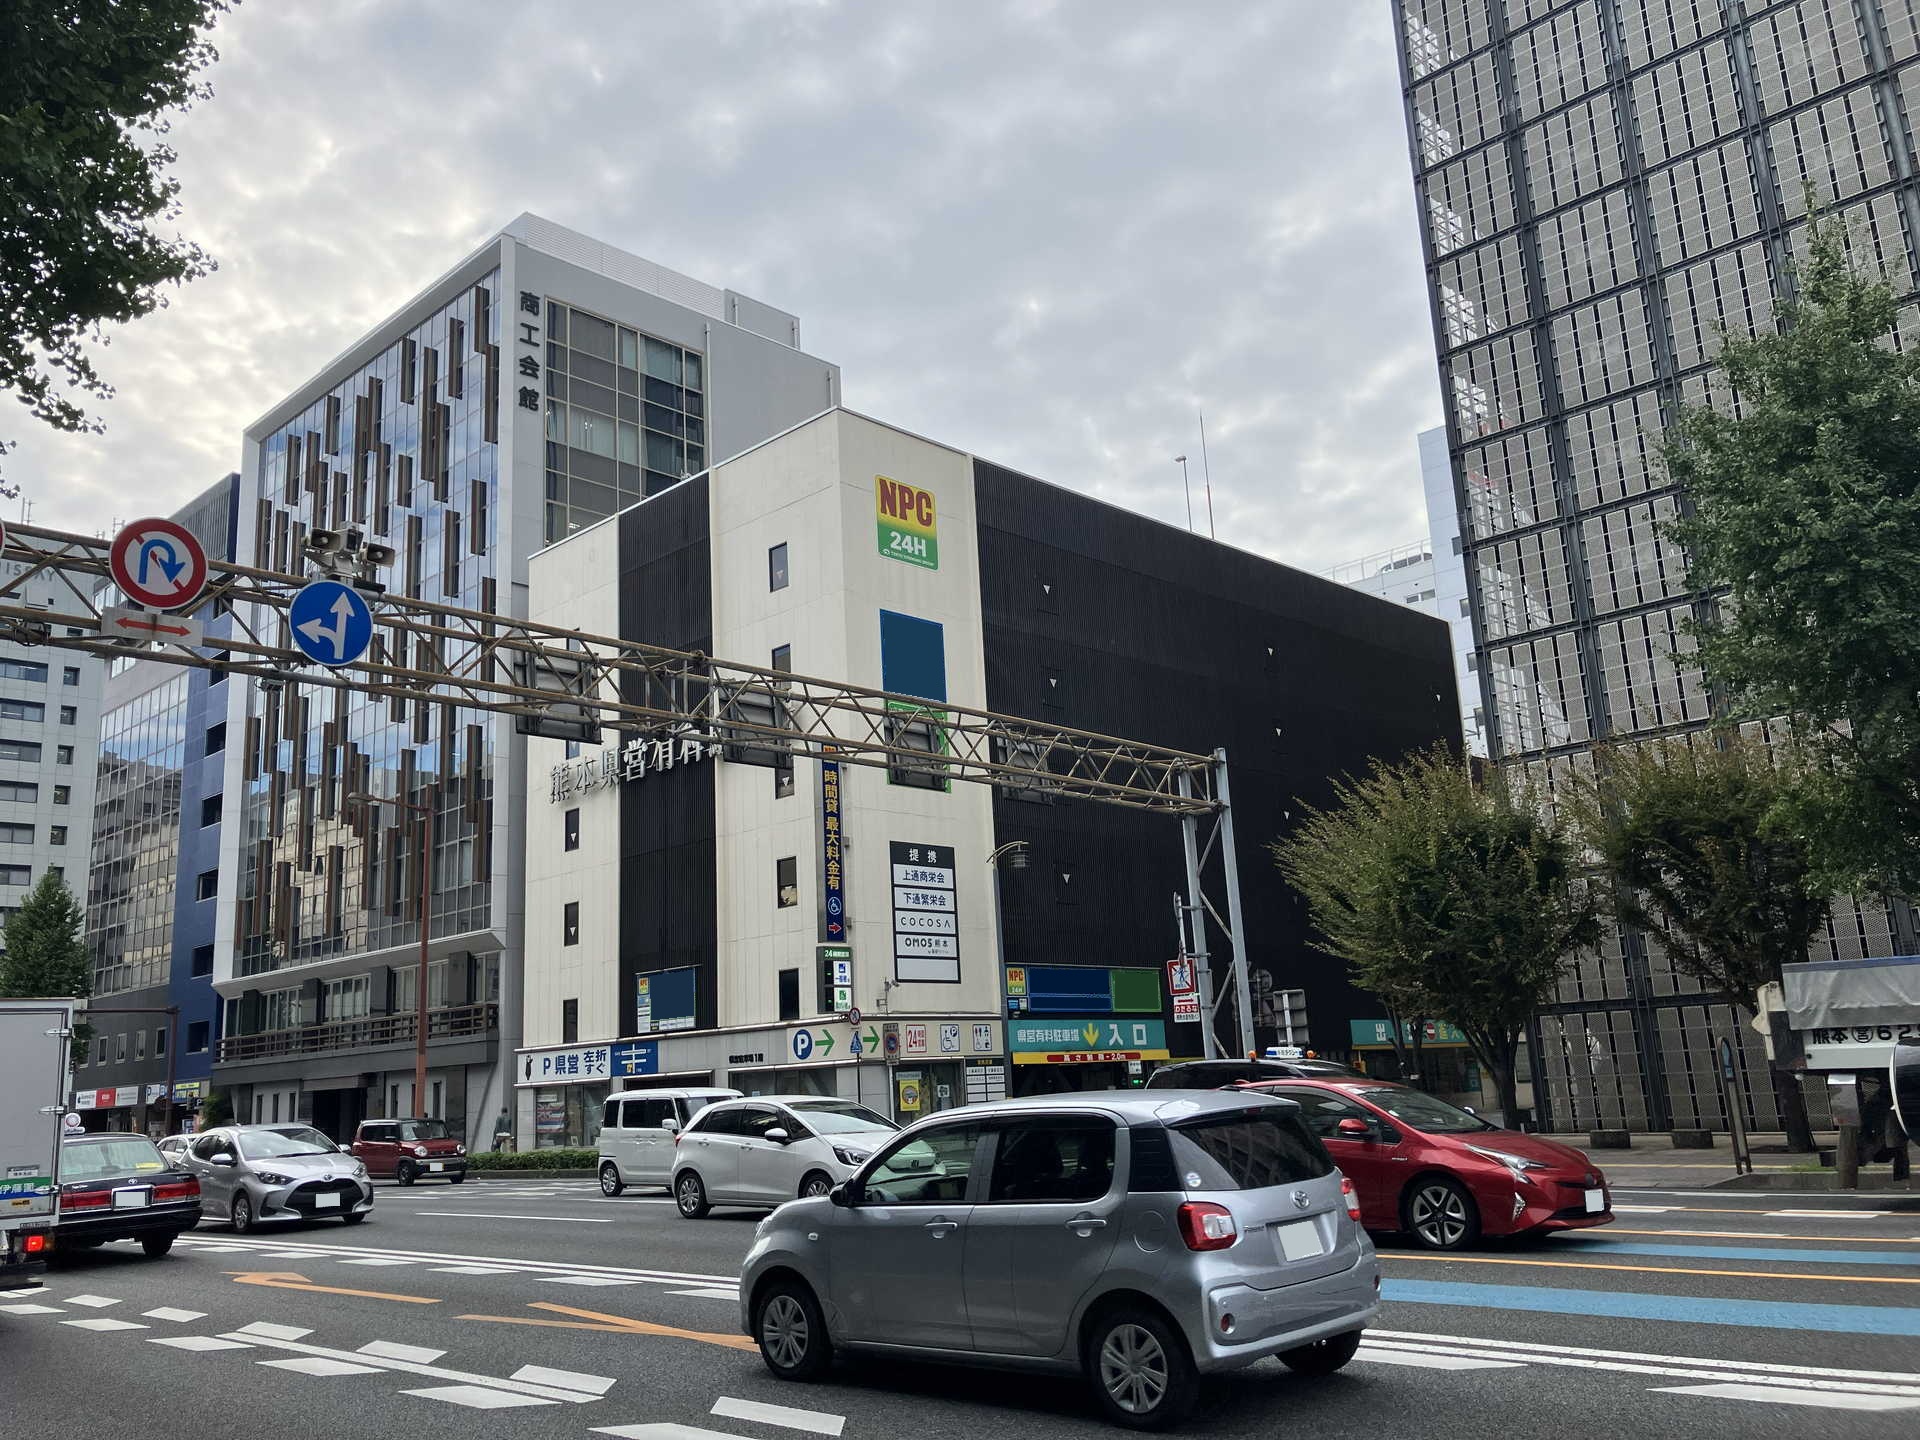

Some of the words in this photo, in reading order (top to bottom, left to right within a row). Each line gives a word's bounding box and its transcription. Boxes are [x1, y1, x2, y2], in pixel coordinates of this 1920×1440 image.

[519, 291, 540, 411] 商工会館
[879, 478, 932, 527] NPC
[890, 531, 927, 557] 24H
[909, 848, 937, 863] 提携
[903, 869, 945, 884] 上通商栄会
[1008, 970, 1024, 981] NPC
[1017, 1029, 1080, 1043] 県営有料駐車場
[1109, 1023, 1148, 1046] 入口
[543, 1057, 551, 1075] P
[555, 1054, 579, 1075] 県営
[583, 1049, 607, 1063] 左折
[585, 1063, 604, 1075] すぐ
